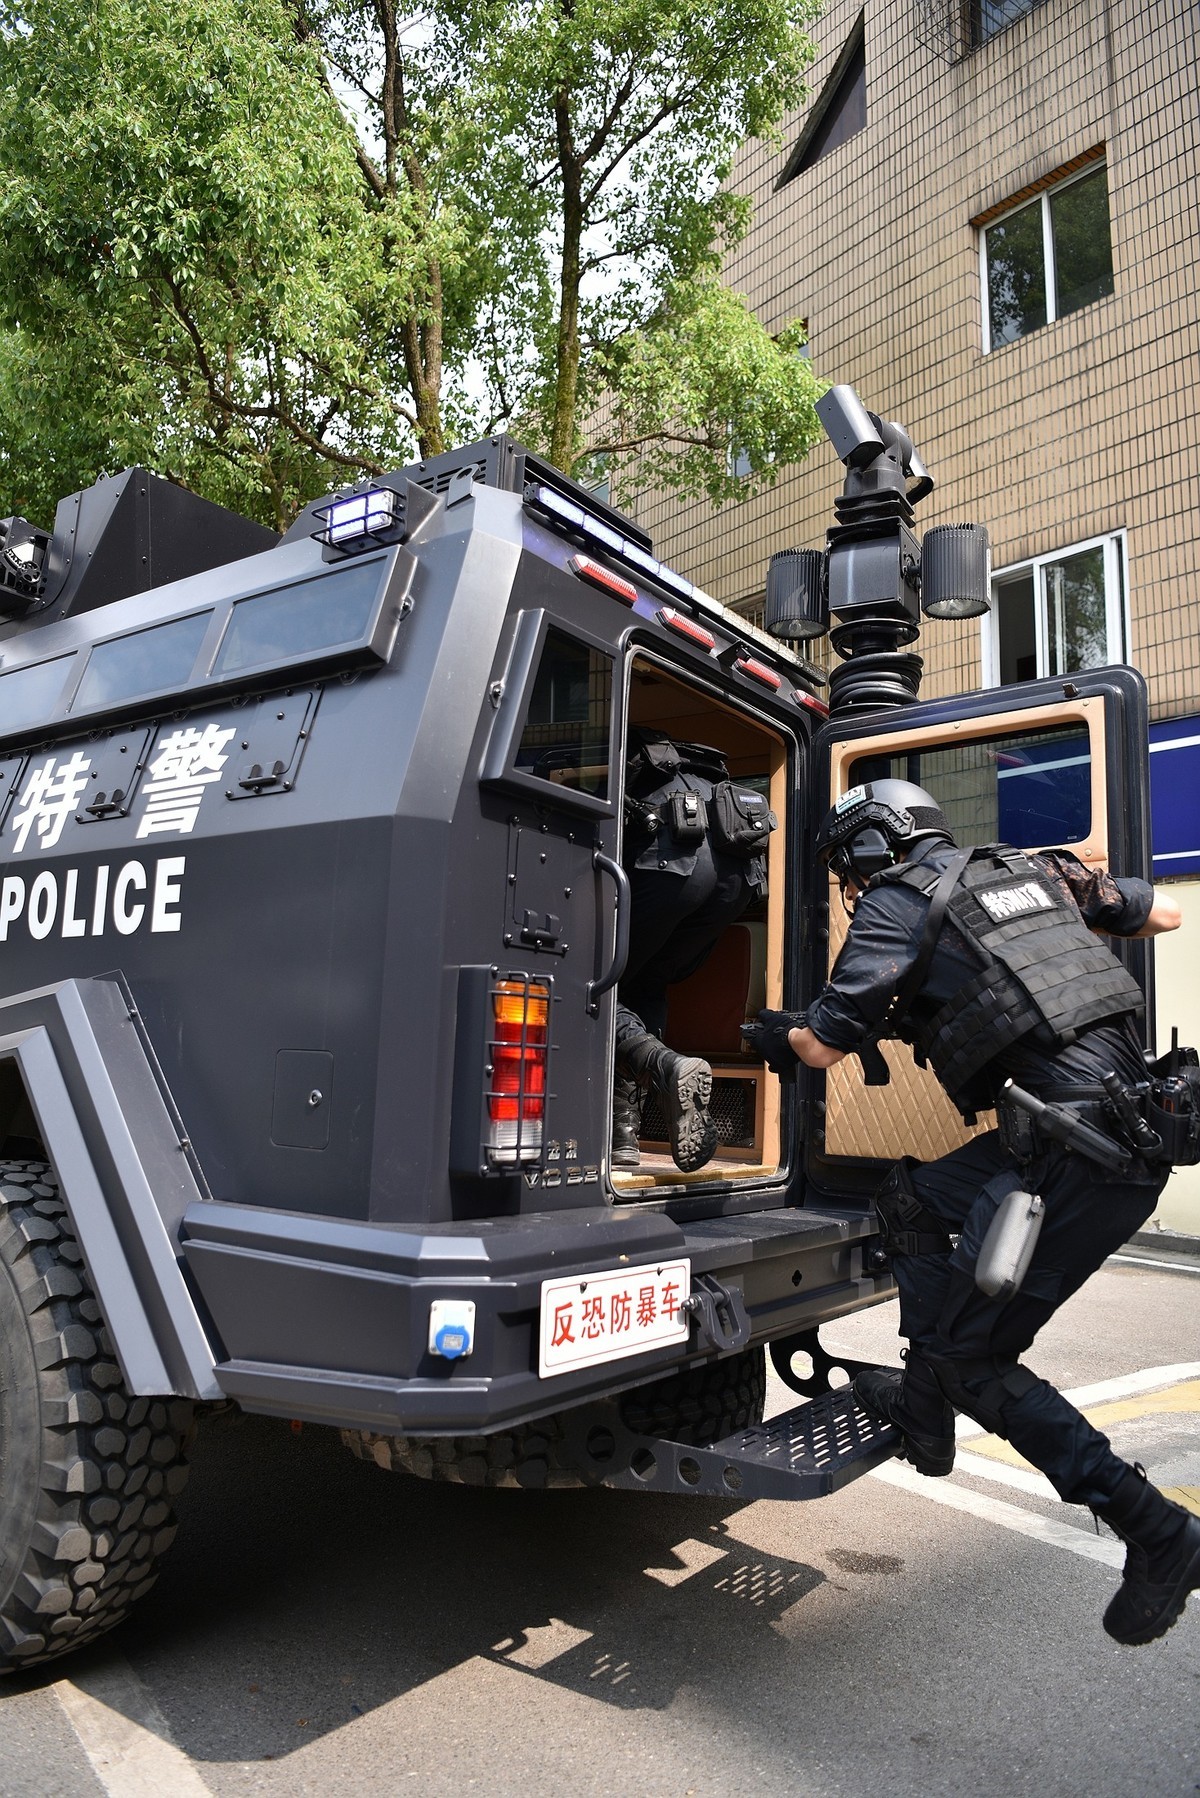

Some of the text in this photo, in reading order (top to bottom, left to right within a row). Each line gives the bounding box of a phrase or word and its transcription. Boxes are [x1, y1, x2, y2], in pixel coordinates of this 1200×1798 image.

[12, 723, 237, 853] 特警
[0, 856, 186, 941] POLICE
[551, 1281, 681, 1347] 反恐防暴车
